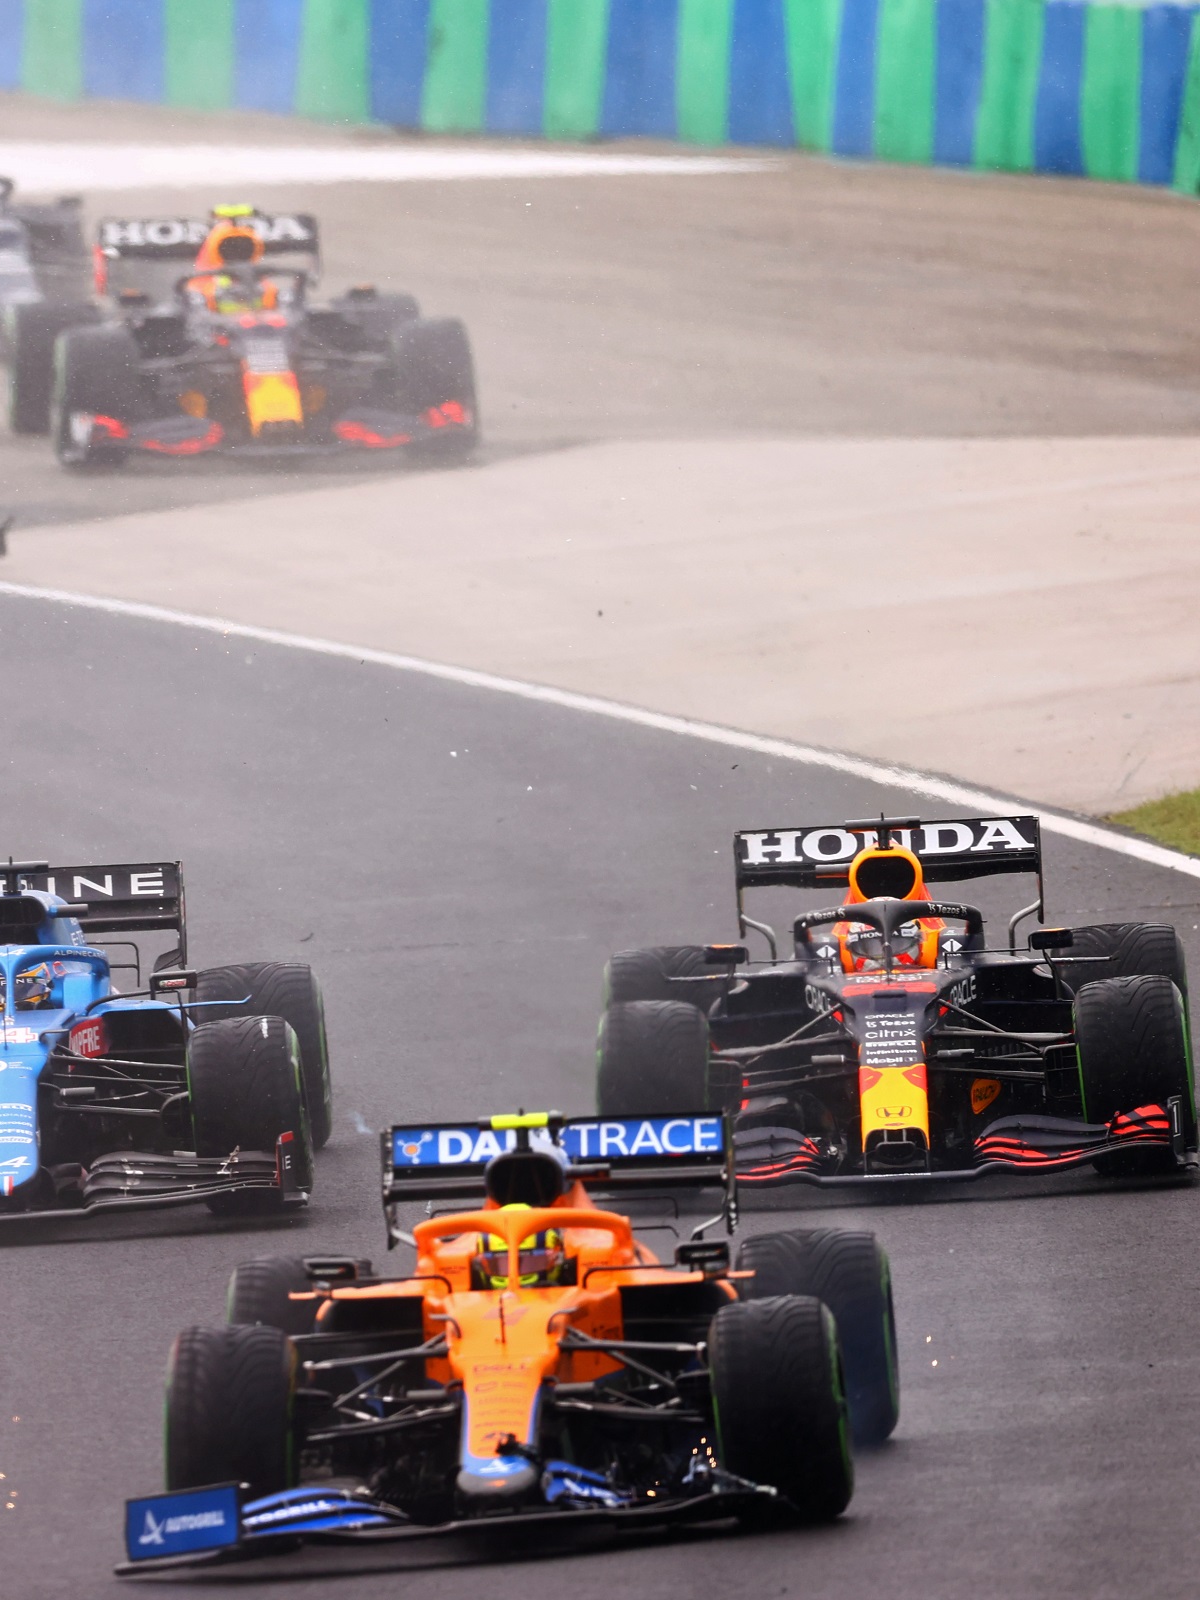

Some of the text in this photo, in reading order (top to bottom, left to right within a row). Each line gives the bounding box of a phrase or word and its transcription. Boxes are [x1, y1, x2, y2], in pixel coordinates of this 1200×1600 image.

[104, 216, 310, 246] HONA
[740, 820, 1035, 864] HONDA
[937, 904, 960, 915] Tezos
[860, 931, 899, 940] HONA
[866, 1056, 904, 1065] Mobil
[438, 1118, 718, 1163] DATRACE
